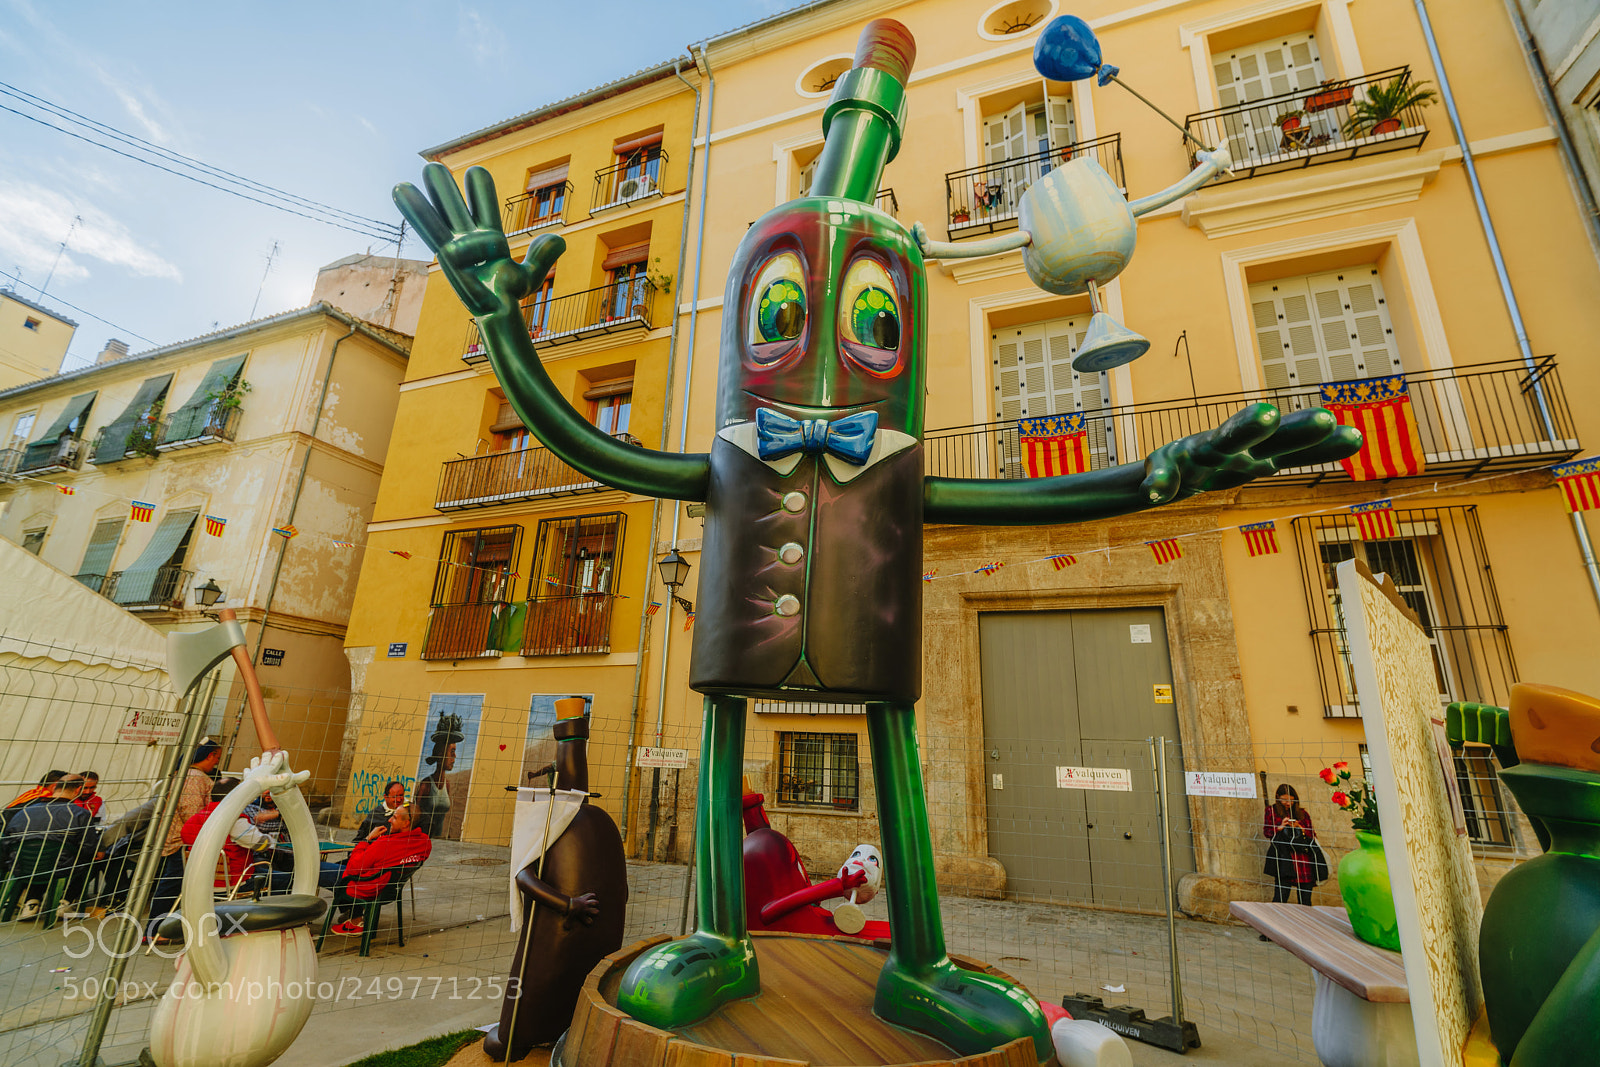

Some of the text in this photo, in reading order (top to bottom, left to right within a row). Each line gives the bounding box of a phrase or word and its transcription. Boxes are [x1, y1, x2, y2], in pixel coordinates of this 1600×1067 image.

[1075, 768, 1122, 780] valquiven
[1203, 773, 1248, 786] valquiven
[1099, 1018, 1140, 1038] VALQUIVEN
